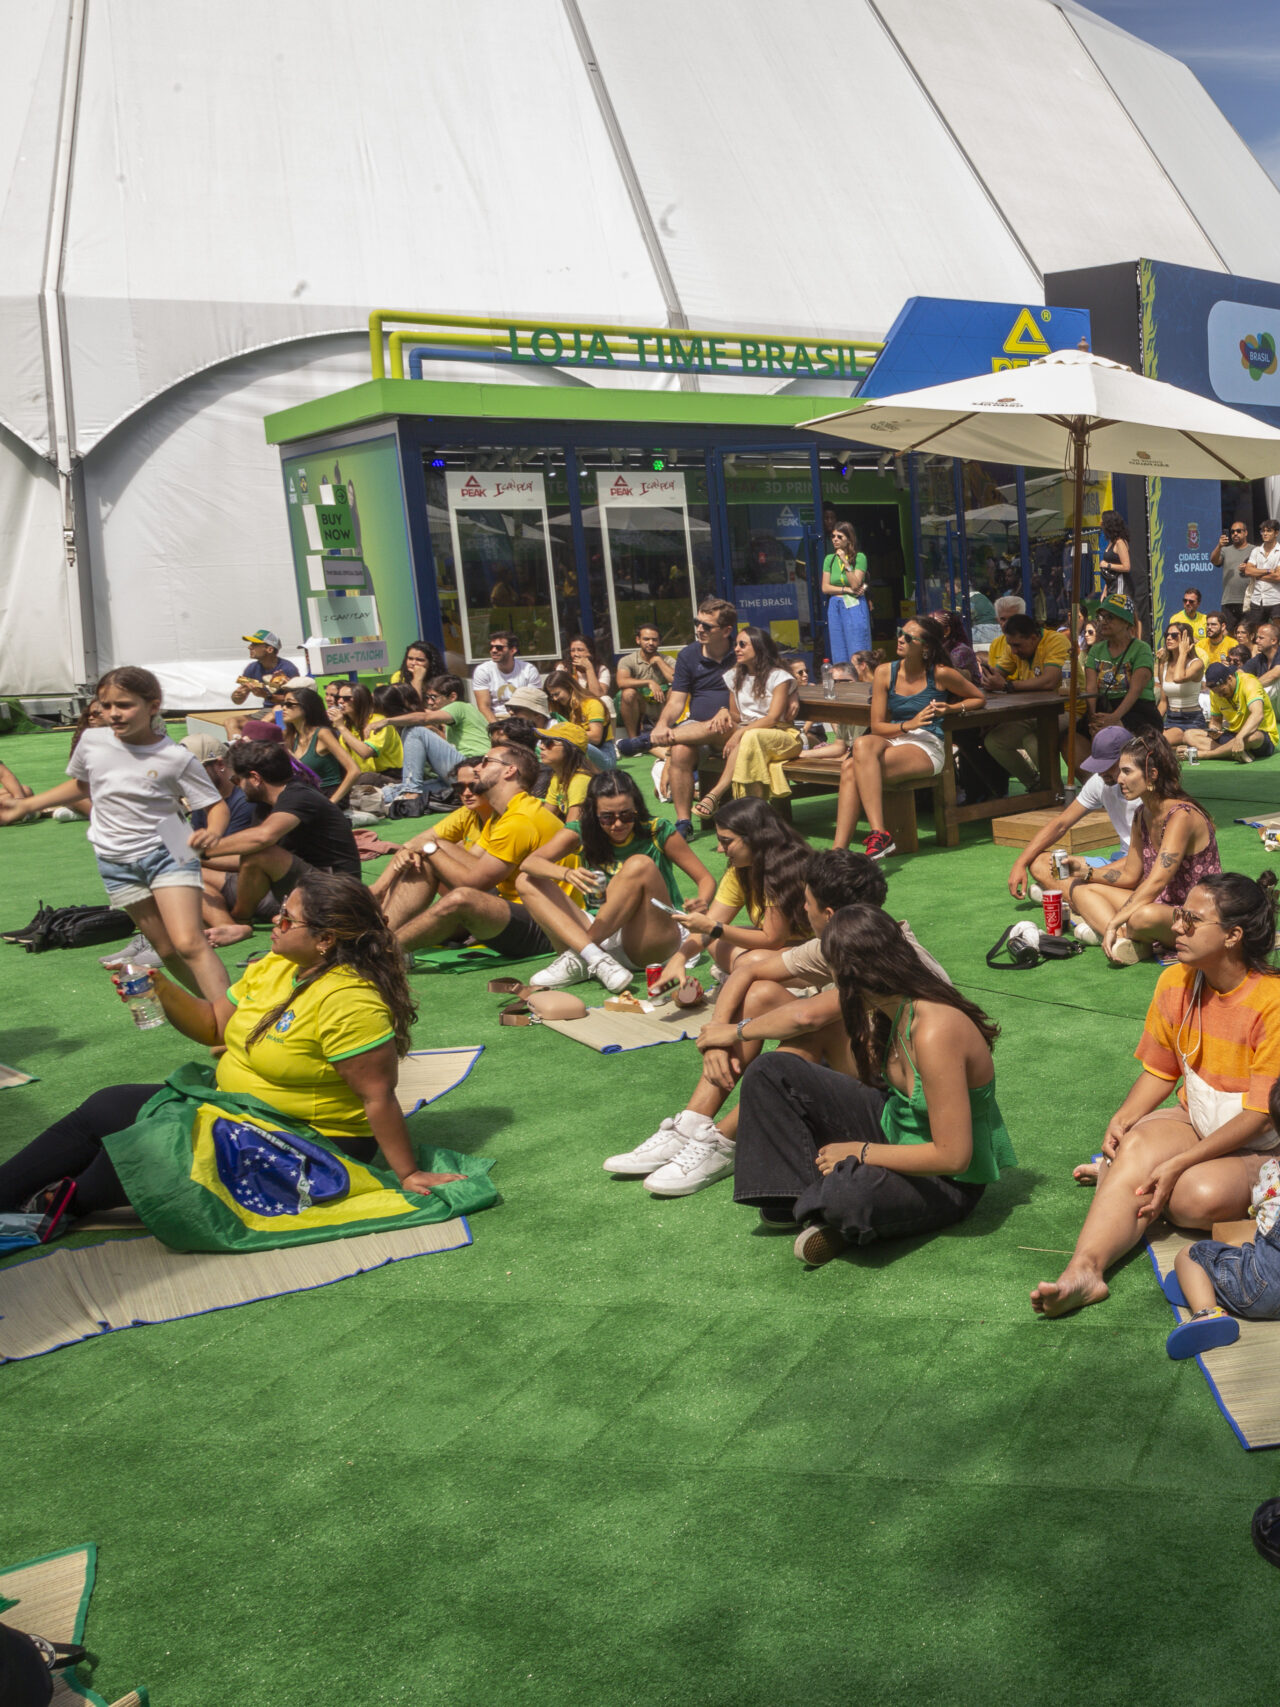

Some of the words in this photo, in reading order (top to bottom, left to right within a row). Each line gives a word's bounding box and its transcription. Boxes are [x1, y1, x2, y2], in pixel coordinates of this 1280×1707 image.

[508, 327, 615, 365] LOJA
[628, 333, 730, 371] TIME
[740, 340, 867, 377] BRASIL
[1250, 351, 1270, 363] BRASIL
[461, 488, 487, 497] PEAK
[610, 488, 633, 496] PEAK
[764, 482, 782, 493] 3D
[321, 514, 342, 525] BUY
[776, 517, 799, 526] PEAK
[324, 529, 351, 541] NOW
[1179, 553, 1200, 561] CIDADE
[1174, 562, 1189, 573] SÃO
[1190, 562, 1213, 572] PAULO
[740, 599, 762, 607] TIME
[763, 598, 792, 607] BRASIL
